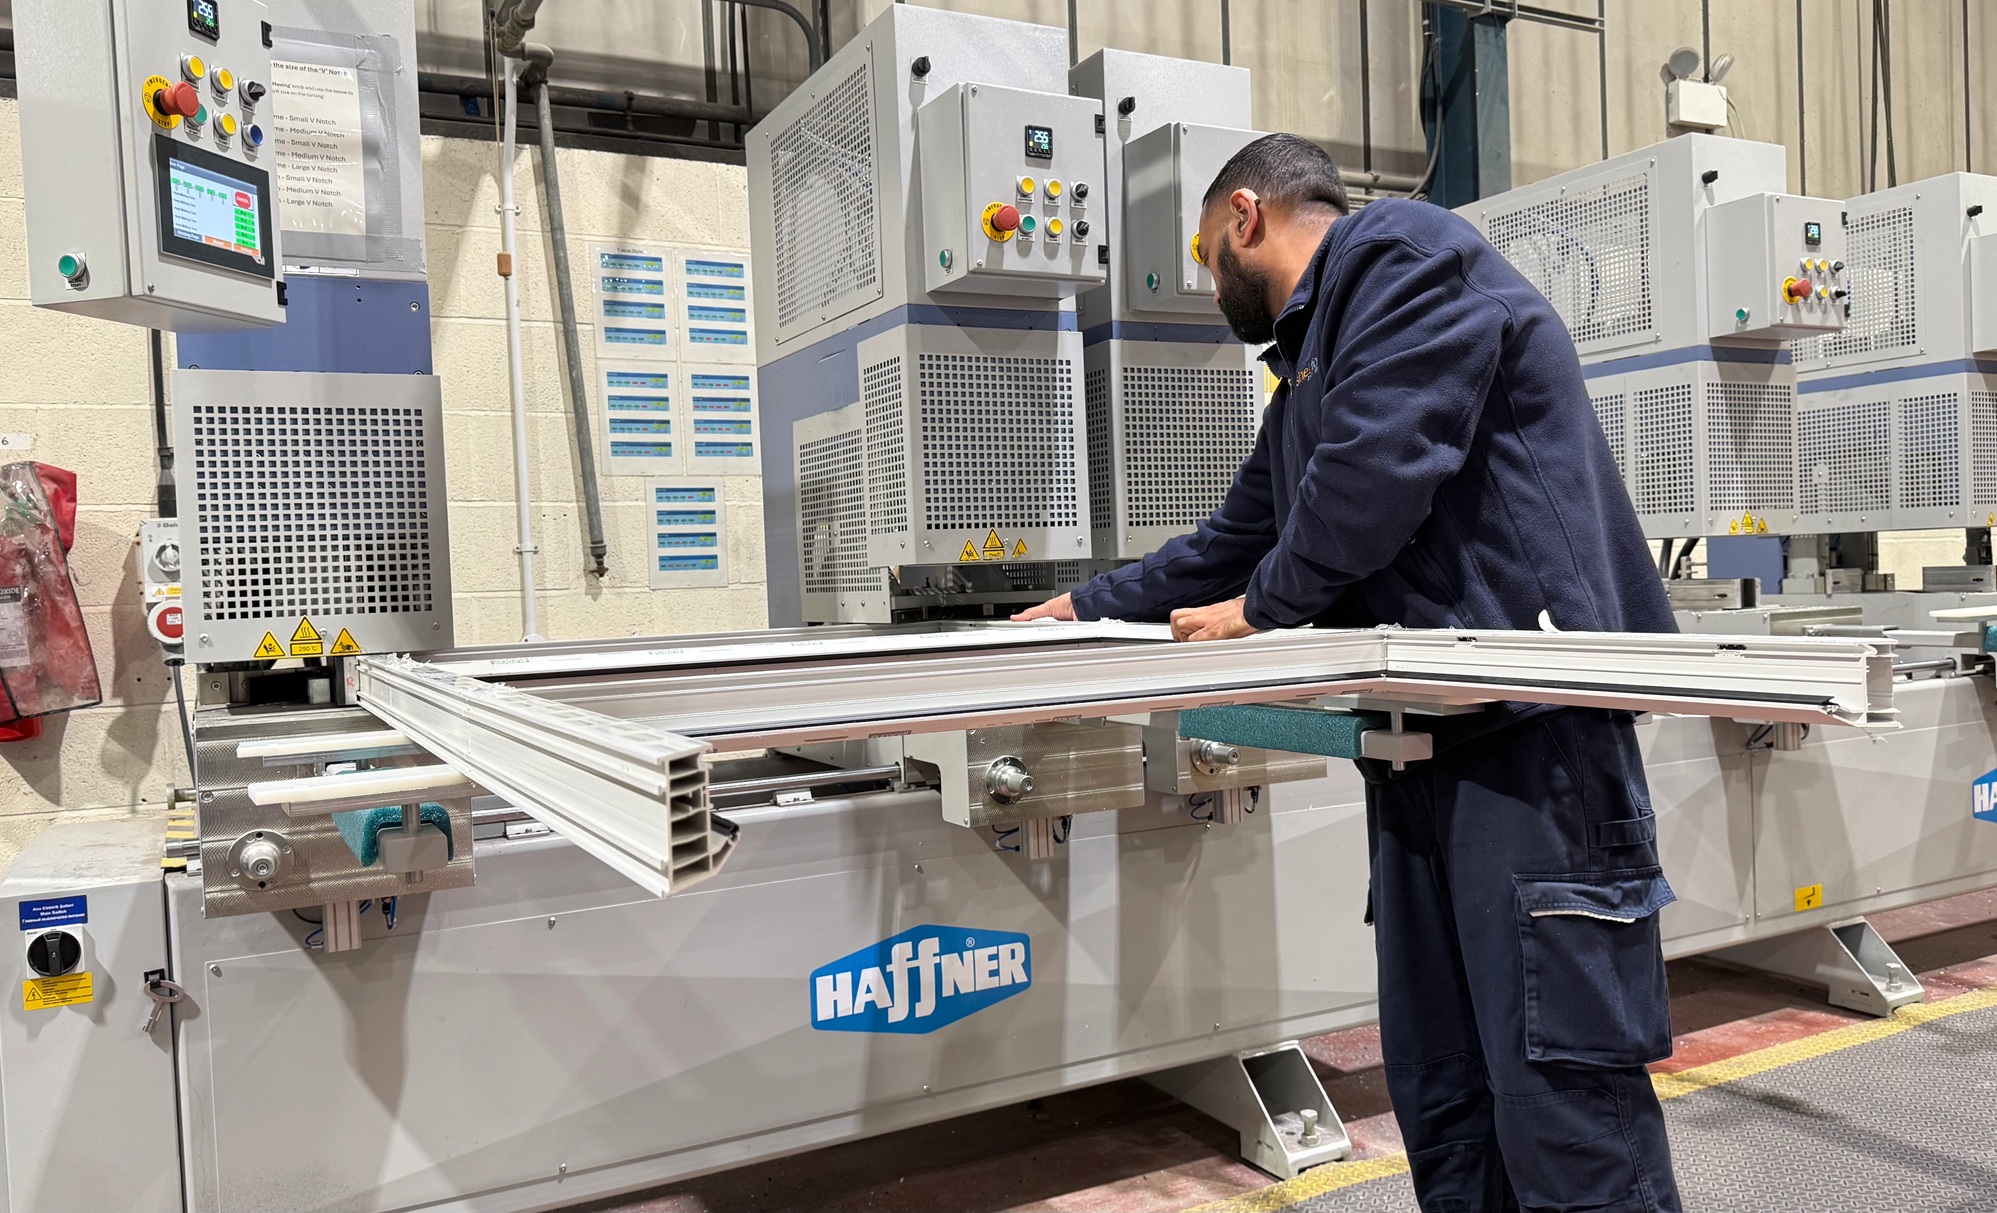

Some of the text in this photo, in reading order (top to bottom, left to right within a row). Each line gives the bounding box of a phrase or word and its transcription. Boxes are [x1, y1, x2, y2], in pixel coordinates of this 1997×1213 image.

[316, 118, 336, 126] Notch
[291, 151, 318, 160] Medium
[2, 436, 8, 445] 6
